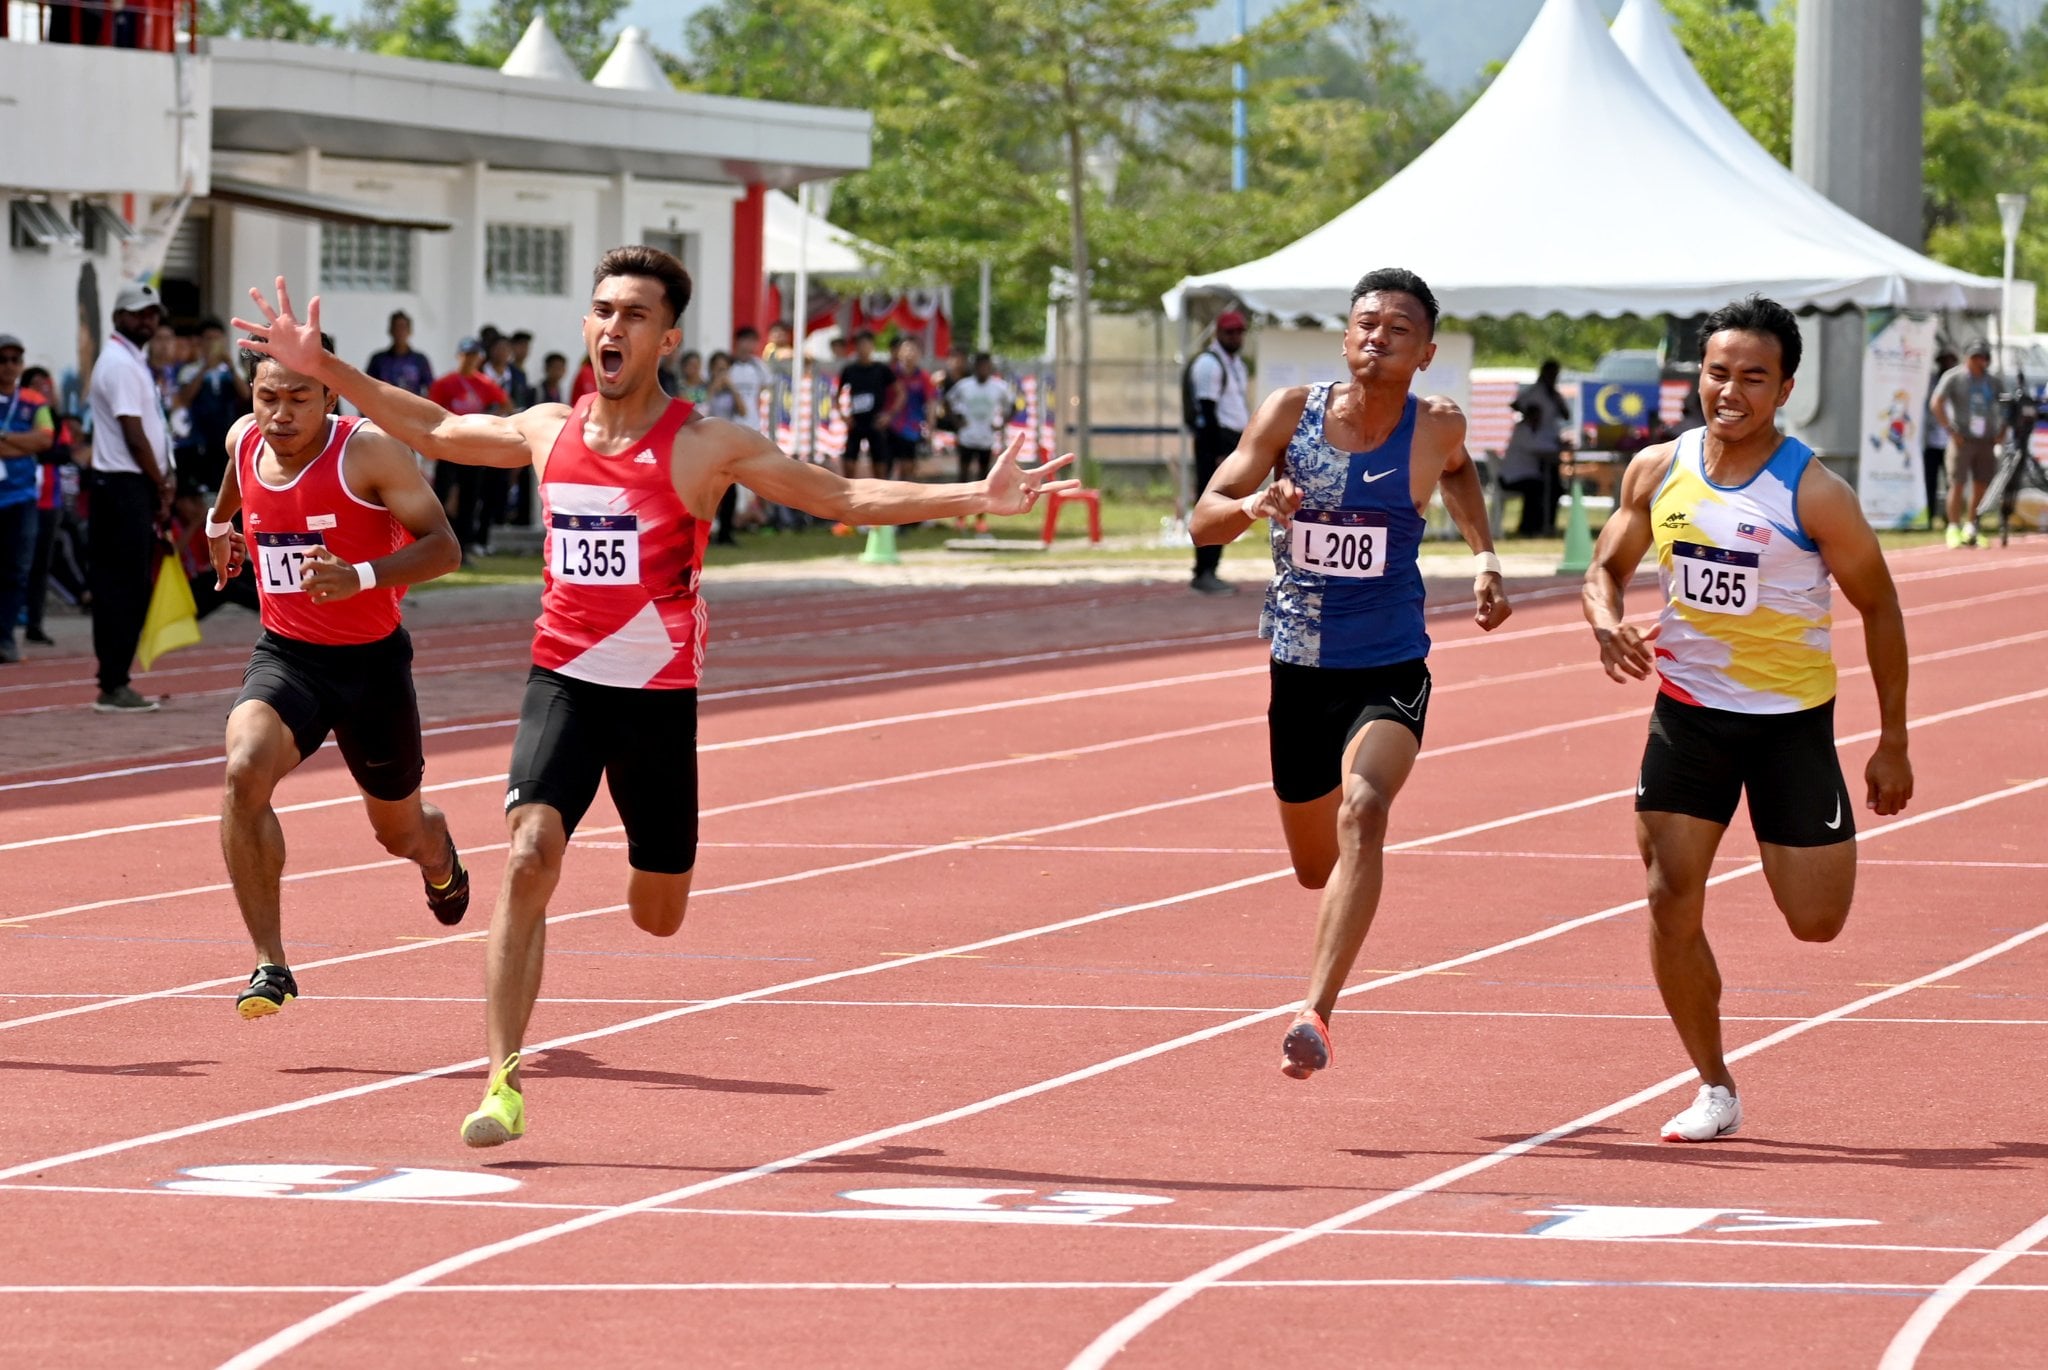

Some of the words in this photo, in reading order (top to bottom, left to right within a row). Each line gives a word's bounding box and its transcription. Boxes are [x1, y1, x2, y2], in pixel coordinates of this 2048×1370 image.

[562, 538, 626, 577] L355
[1305, 530, 1373, 570] L208
[1684, 564, 1746, 607] L255
